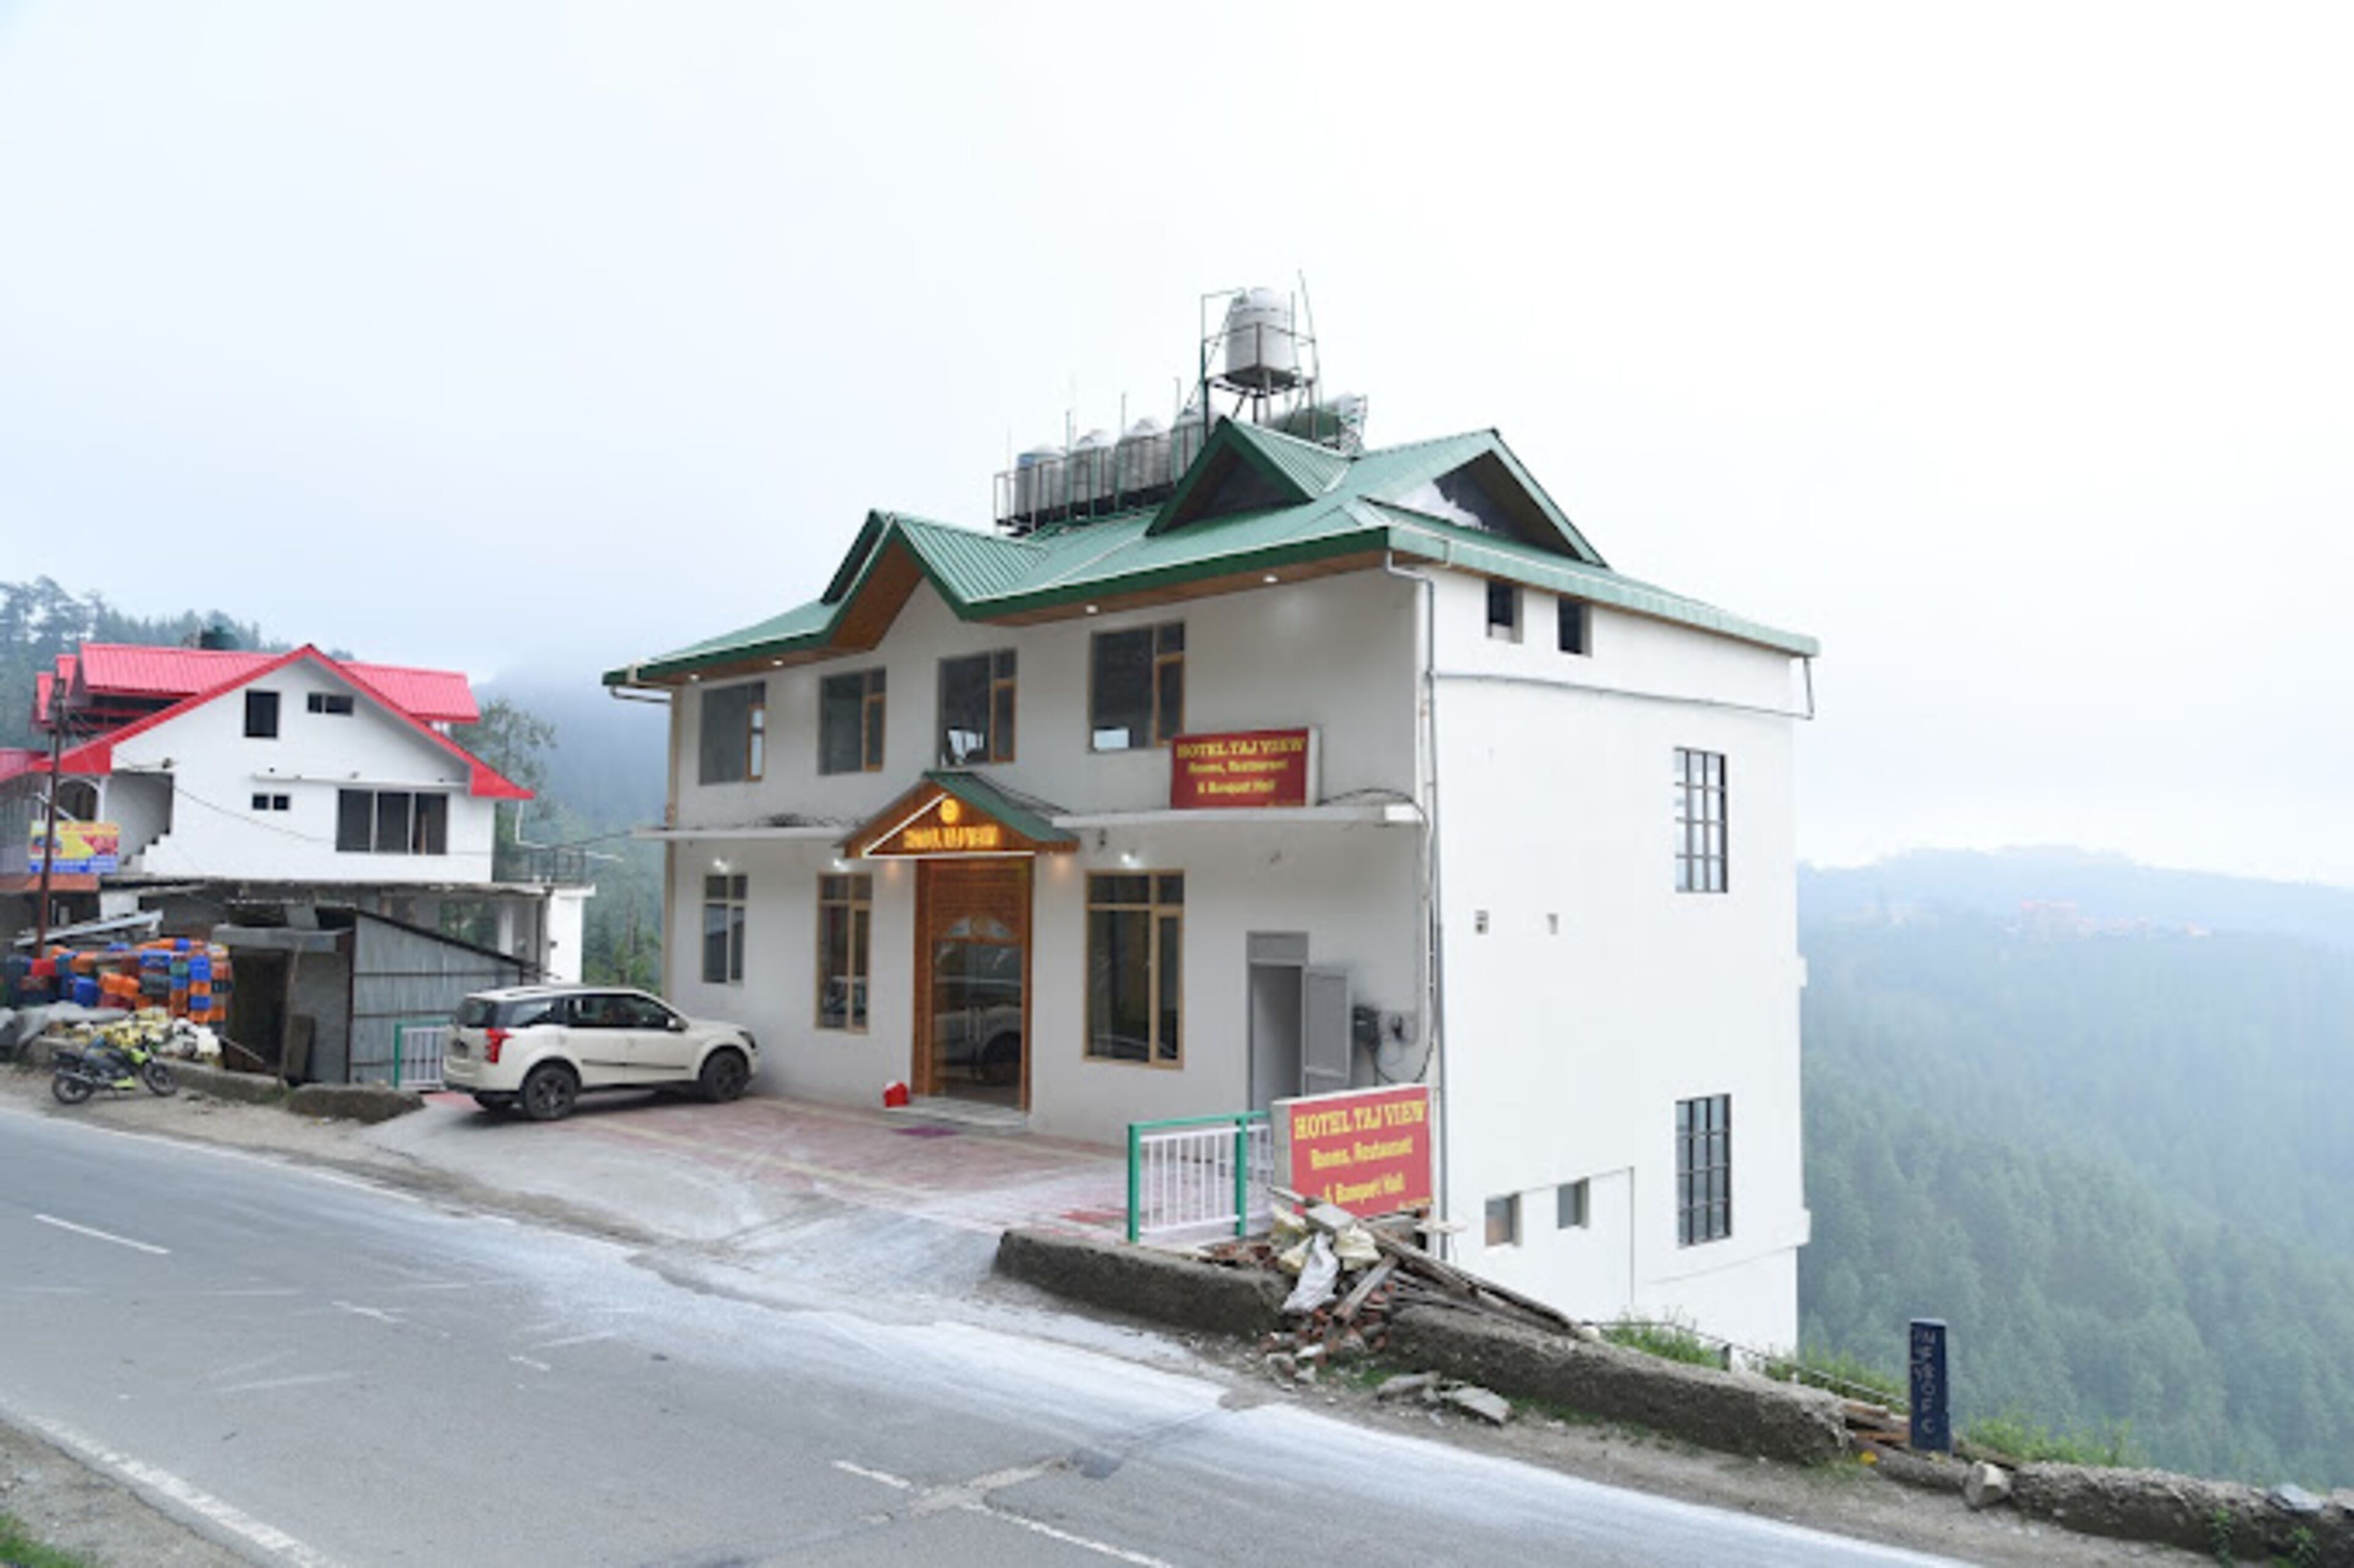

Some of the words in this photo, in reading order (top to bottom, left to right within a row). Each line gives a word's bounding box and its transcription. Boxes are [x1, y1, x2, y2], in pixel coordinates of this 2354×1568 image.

[1176, 743, 1227, 759] HOTEL
[1229, 740, 1257, 755] TAJ
[1259, 737, 1303, 754] VIEW
[1294, 1110, 1352, 1140] HOTEL
[1354, 1106, 1381, 1130] TAJ
[1384, 1100, 1427, 1125] VIEW
